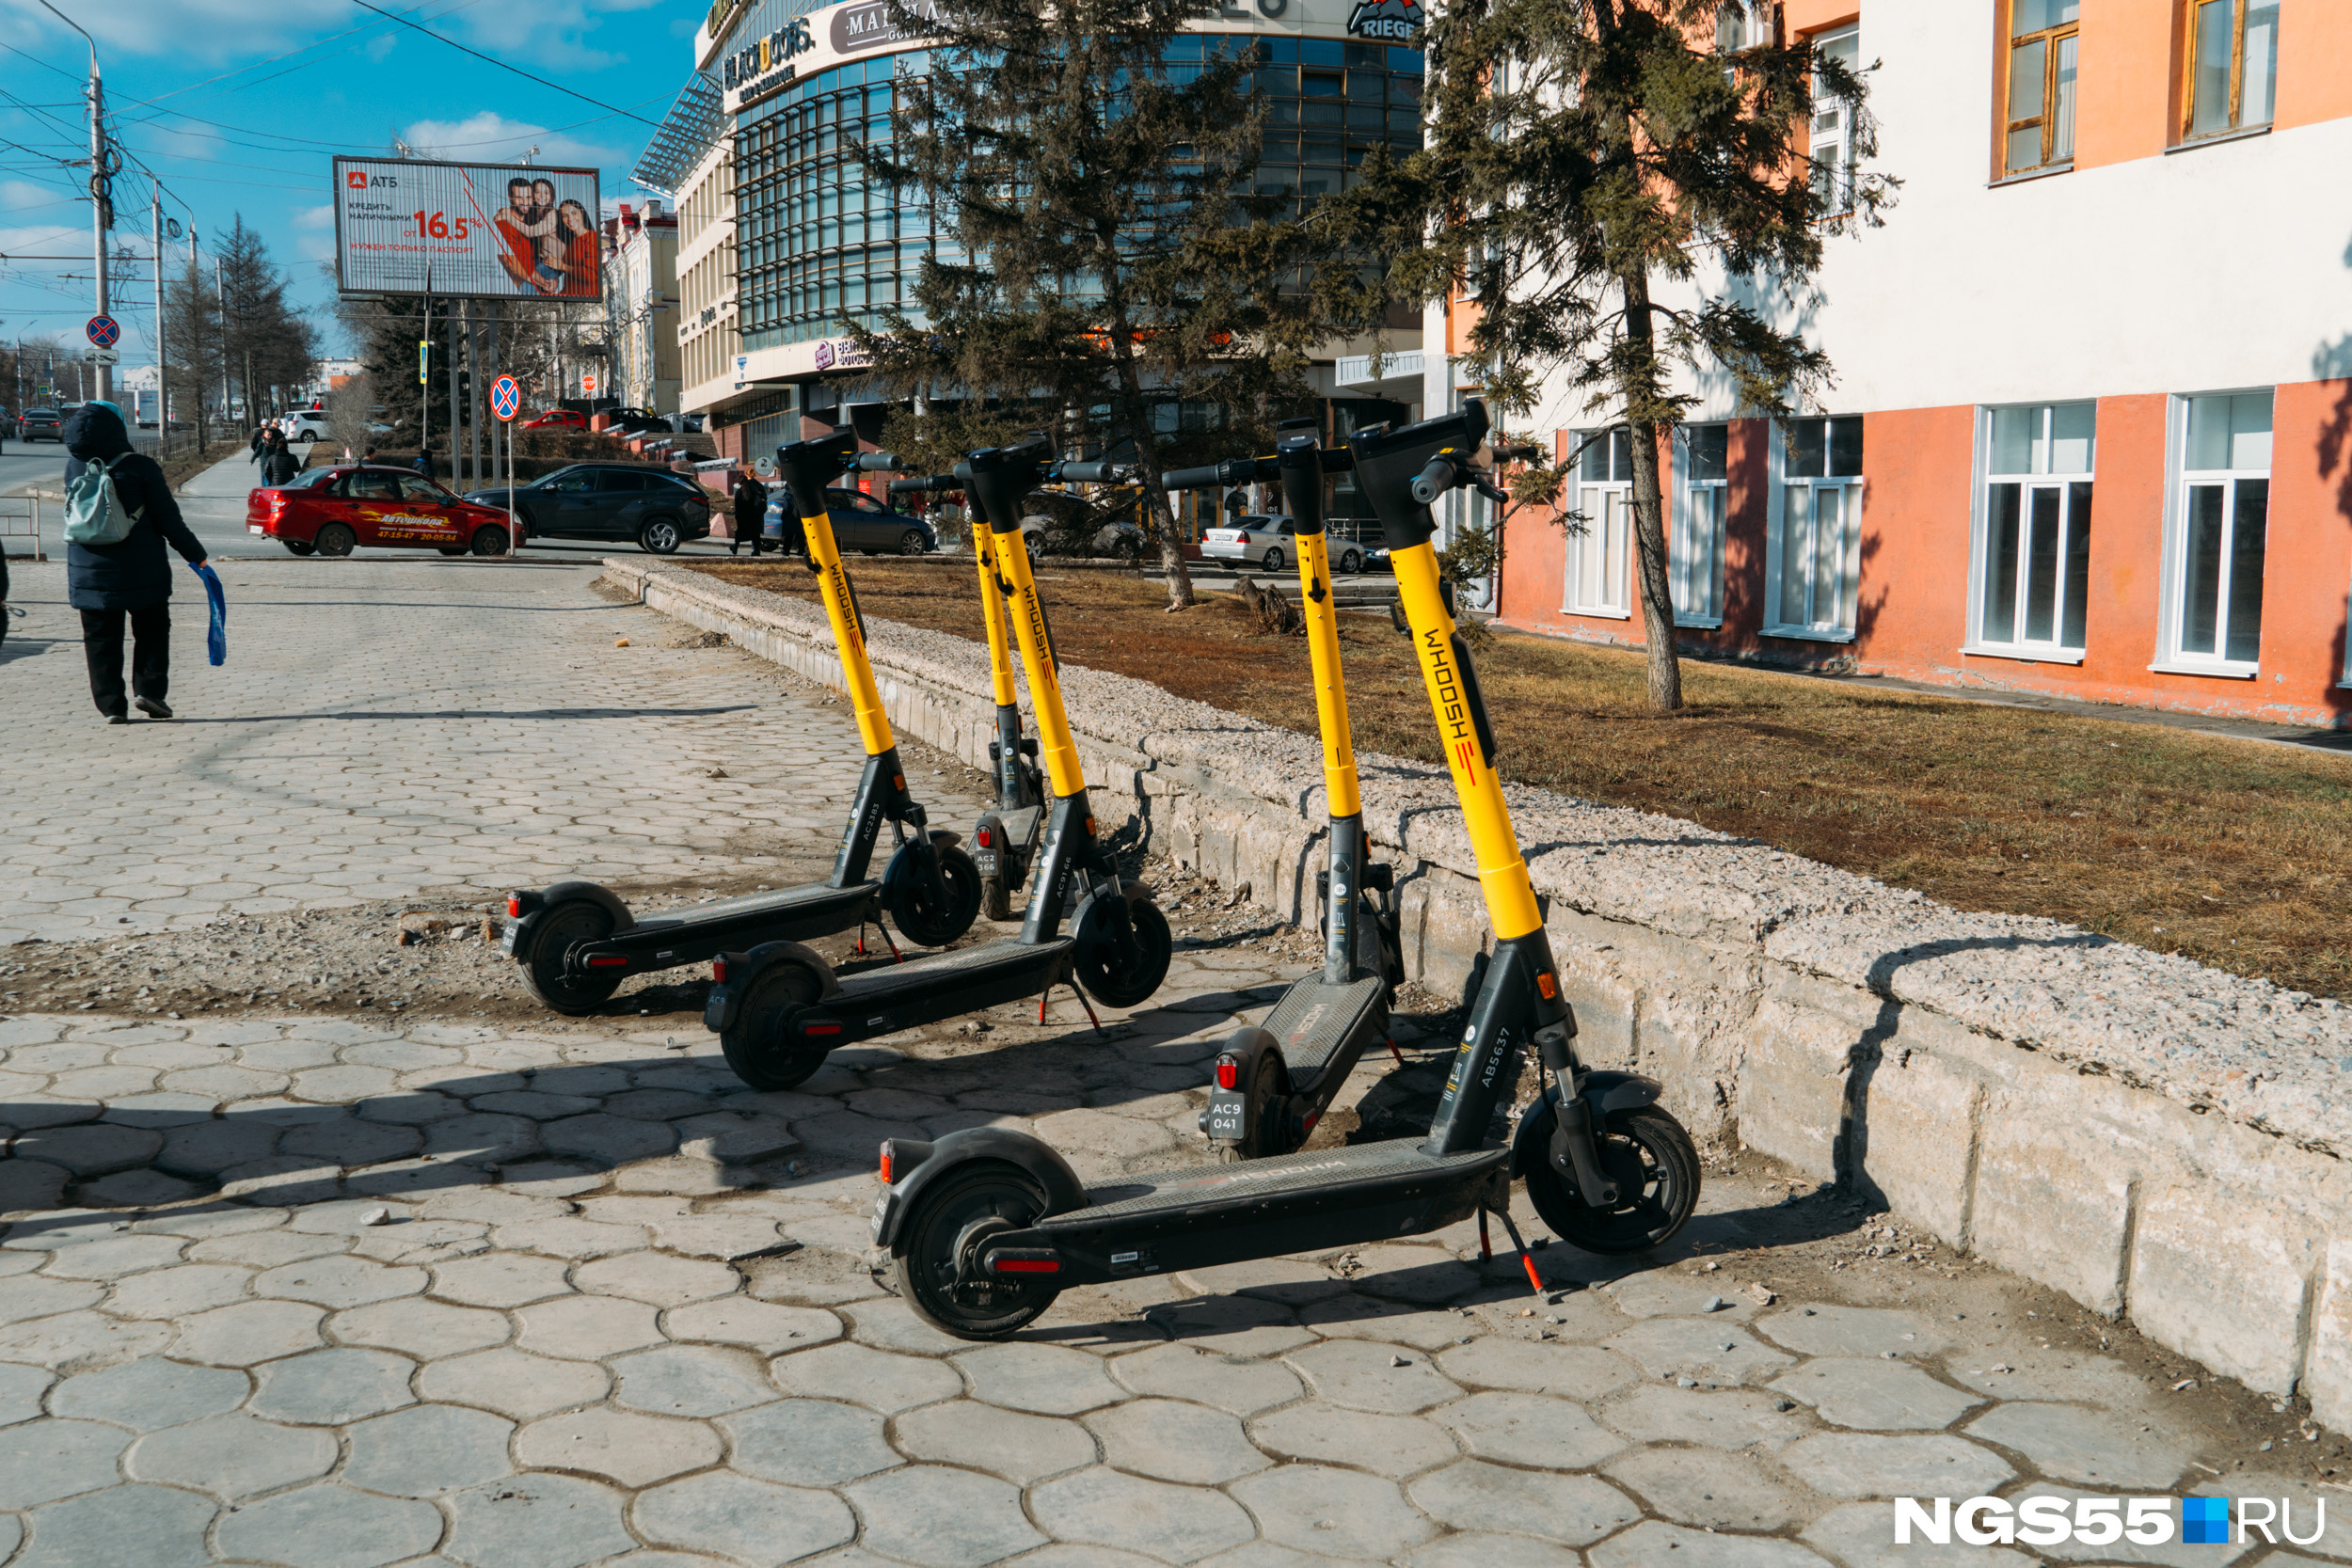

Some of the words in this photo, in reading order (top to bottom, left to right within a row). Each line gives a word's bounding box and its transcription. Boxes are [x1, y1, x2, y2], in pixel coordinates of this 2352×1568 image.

[370, 176, 398, 188] АТБ
[349, 213, 412, 222] НАЛИЧНЫМИ
[350, 243, 387, 251] НУЖЕН
[388, 244, 427, 252] ТОЛЬКО
[429, 245, 475, 254] ПАСПОРТ
[377, 531, 414, 540] 47-15-47
[830, 562, 856, 630] WHOOSH
[1024, 584, 1049, 659] WHOOSH
[1423, 628, 1469, 738] WHOOSH
[977, 854, 995, 863] AC2
[1482, 1027, 1510, 1088] AB5637
[1213, 1103, 1241, 1115] AC9
[1214, 1117, 1236, 1129] 041
